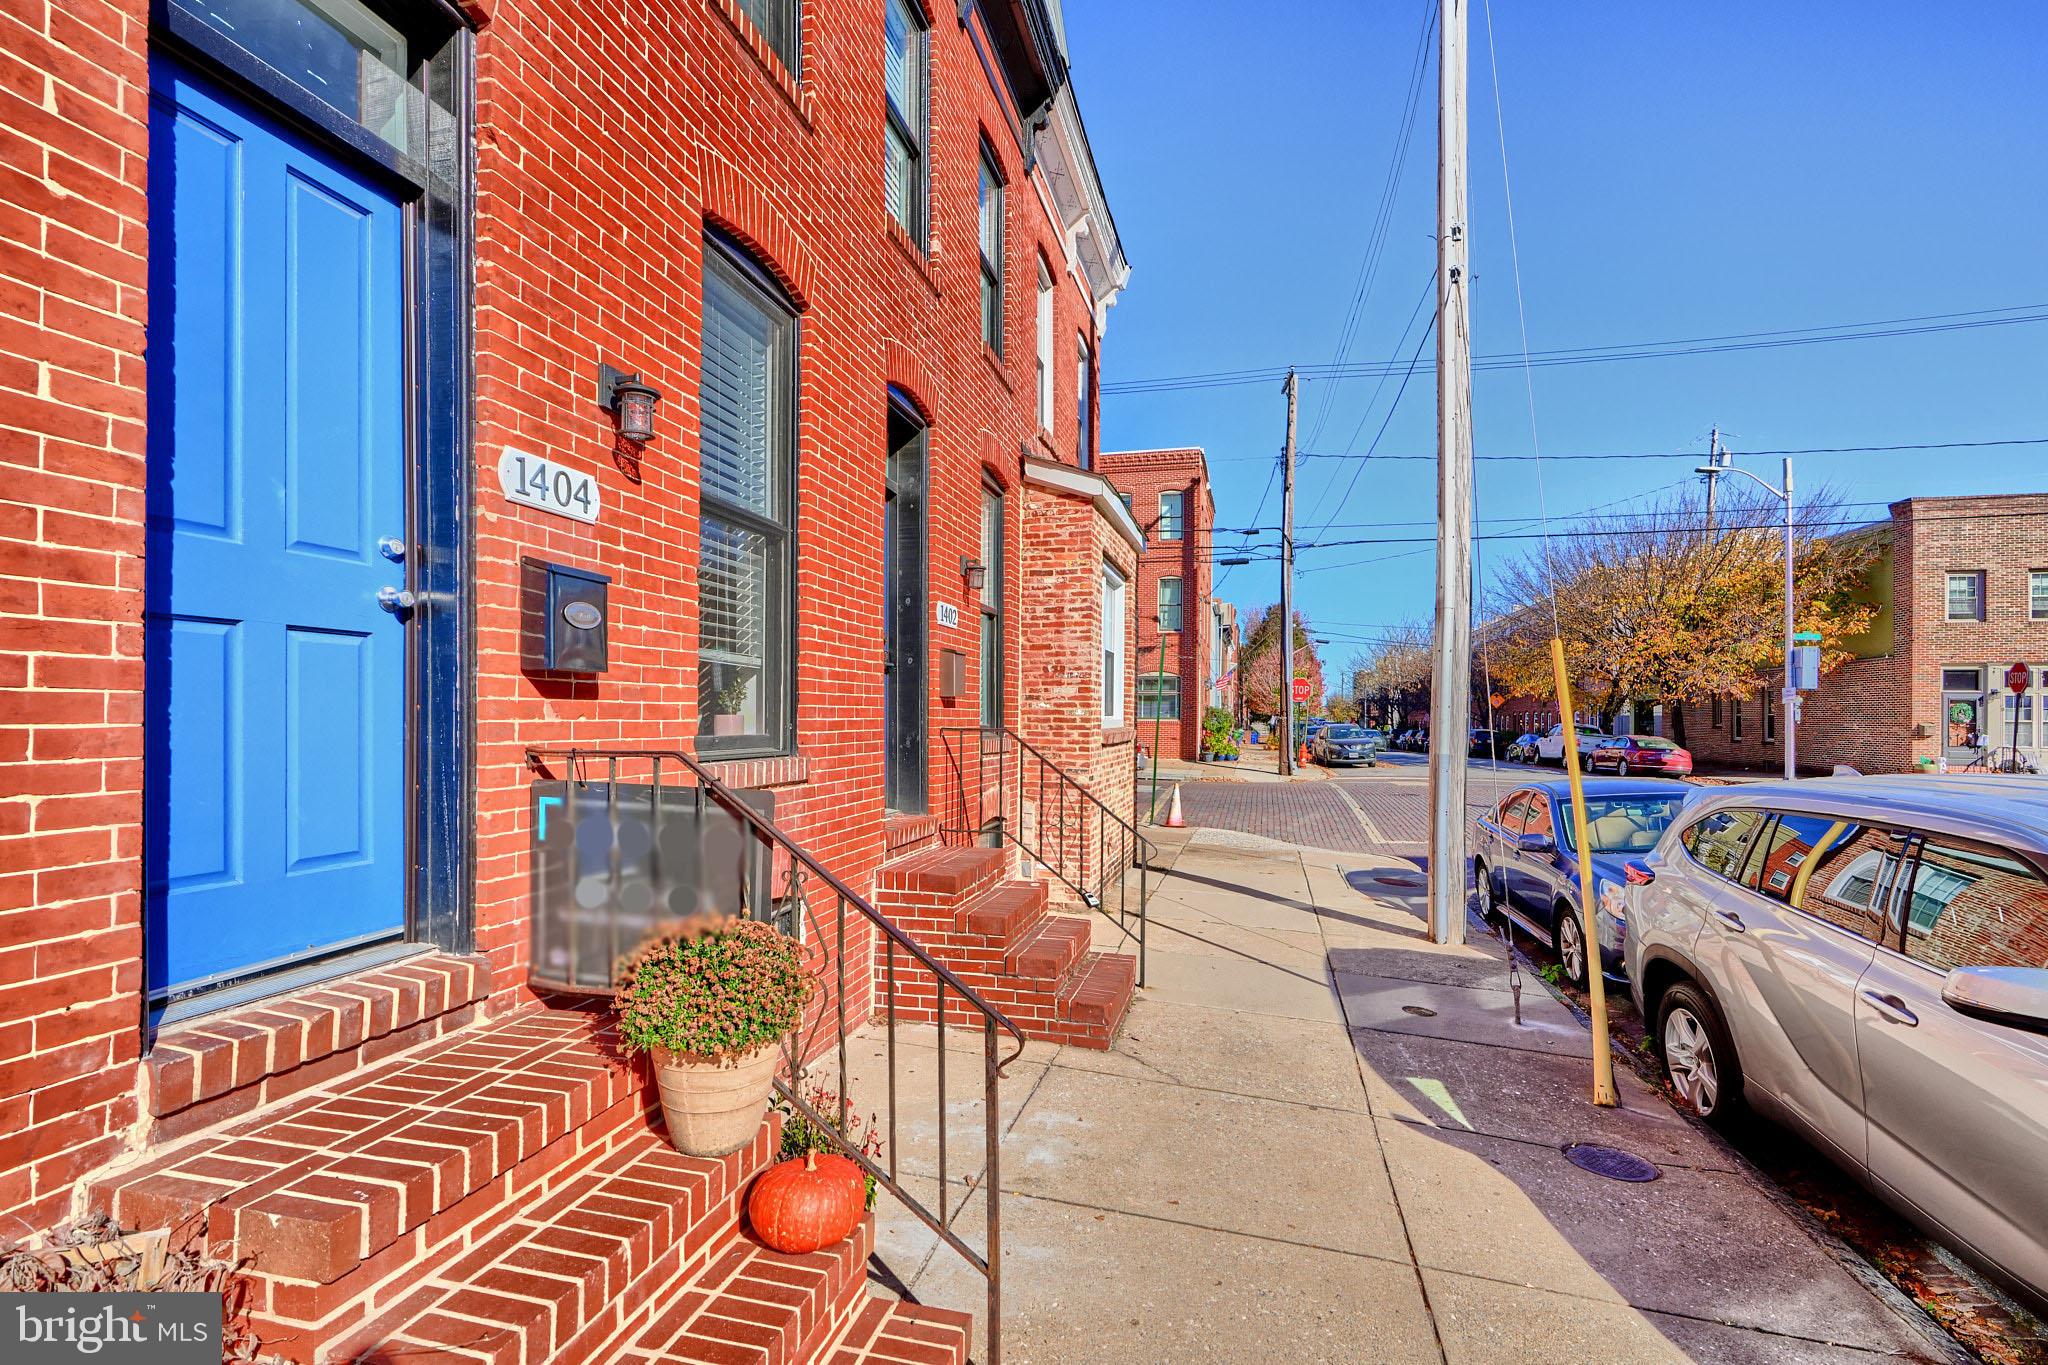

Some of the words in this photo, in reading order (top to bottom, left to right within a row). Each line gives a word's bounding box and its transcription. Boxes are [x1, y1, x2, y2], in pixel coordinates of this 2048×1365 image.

[515, 457, 591, 514] 1404
[940, 605, 957, 625] 1402
[2009, 672, 2027, 684] STOP
[1292, 685, 1310, 695] TOP
